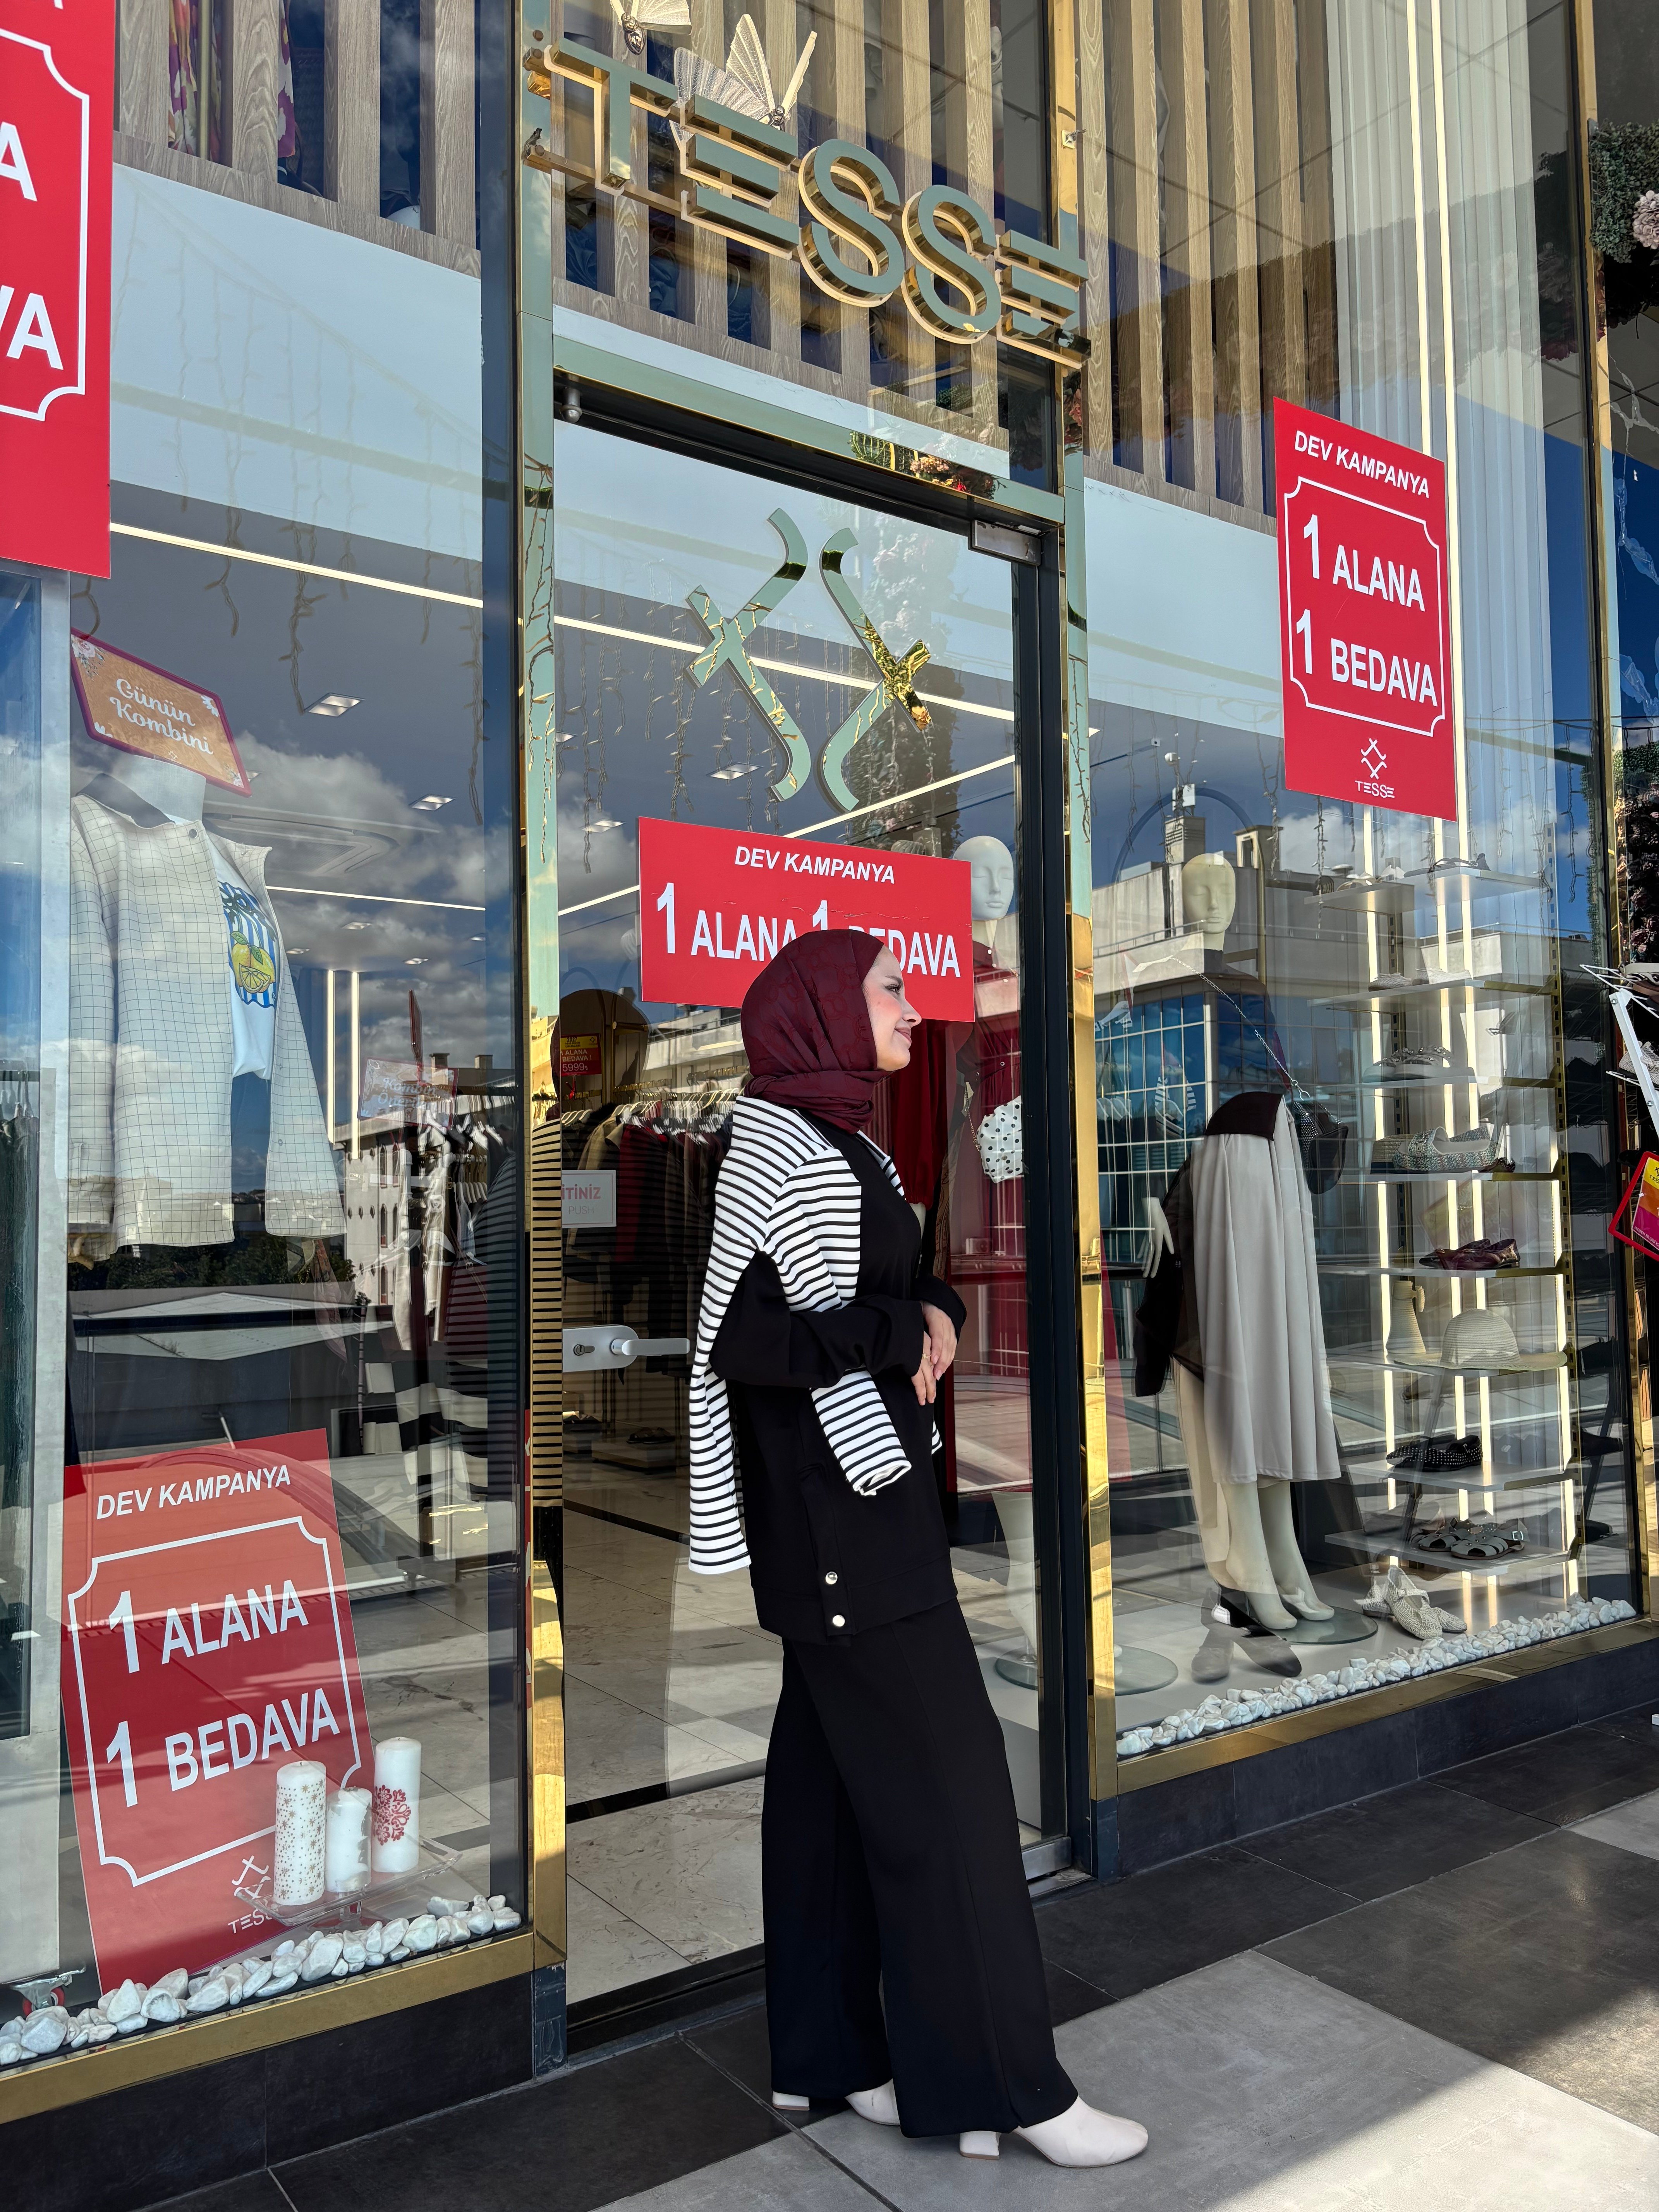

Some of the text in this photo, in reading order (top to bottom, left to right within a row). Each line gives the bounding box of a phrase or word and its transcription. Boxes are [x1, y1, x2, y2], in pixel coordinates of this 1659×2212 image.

[544, 38, 1091, 370] TESSE
[1295, 430, 1429, 498] DEV KAMPANYA
[1304, 514, 1425, 612] 1 ALANA
[1296, 609, 1438, 707] 1 BEDAVA
[110, 697, 214, 755] Kombini
[117, 679, 196, 726] Günün
[1355, 780, 1395, 799] TESSE
[735, 846, 895, 884] DEV KAMPANYA
[657, 882, 675, 954] 1
[848, 925, 961, 978] DAVA
[569, 1206, 594, 1214] PUSH
[96, 1465, 291, 1520] DEV KAMPANYA
[108, 1579, 309, 1673] 1 ALANA
[106, 1688, 340, 1807] 1 BEDAVA
